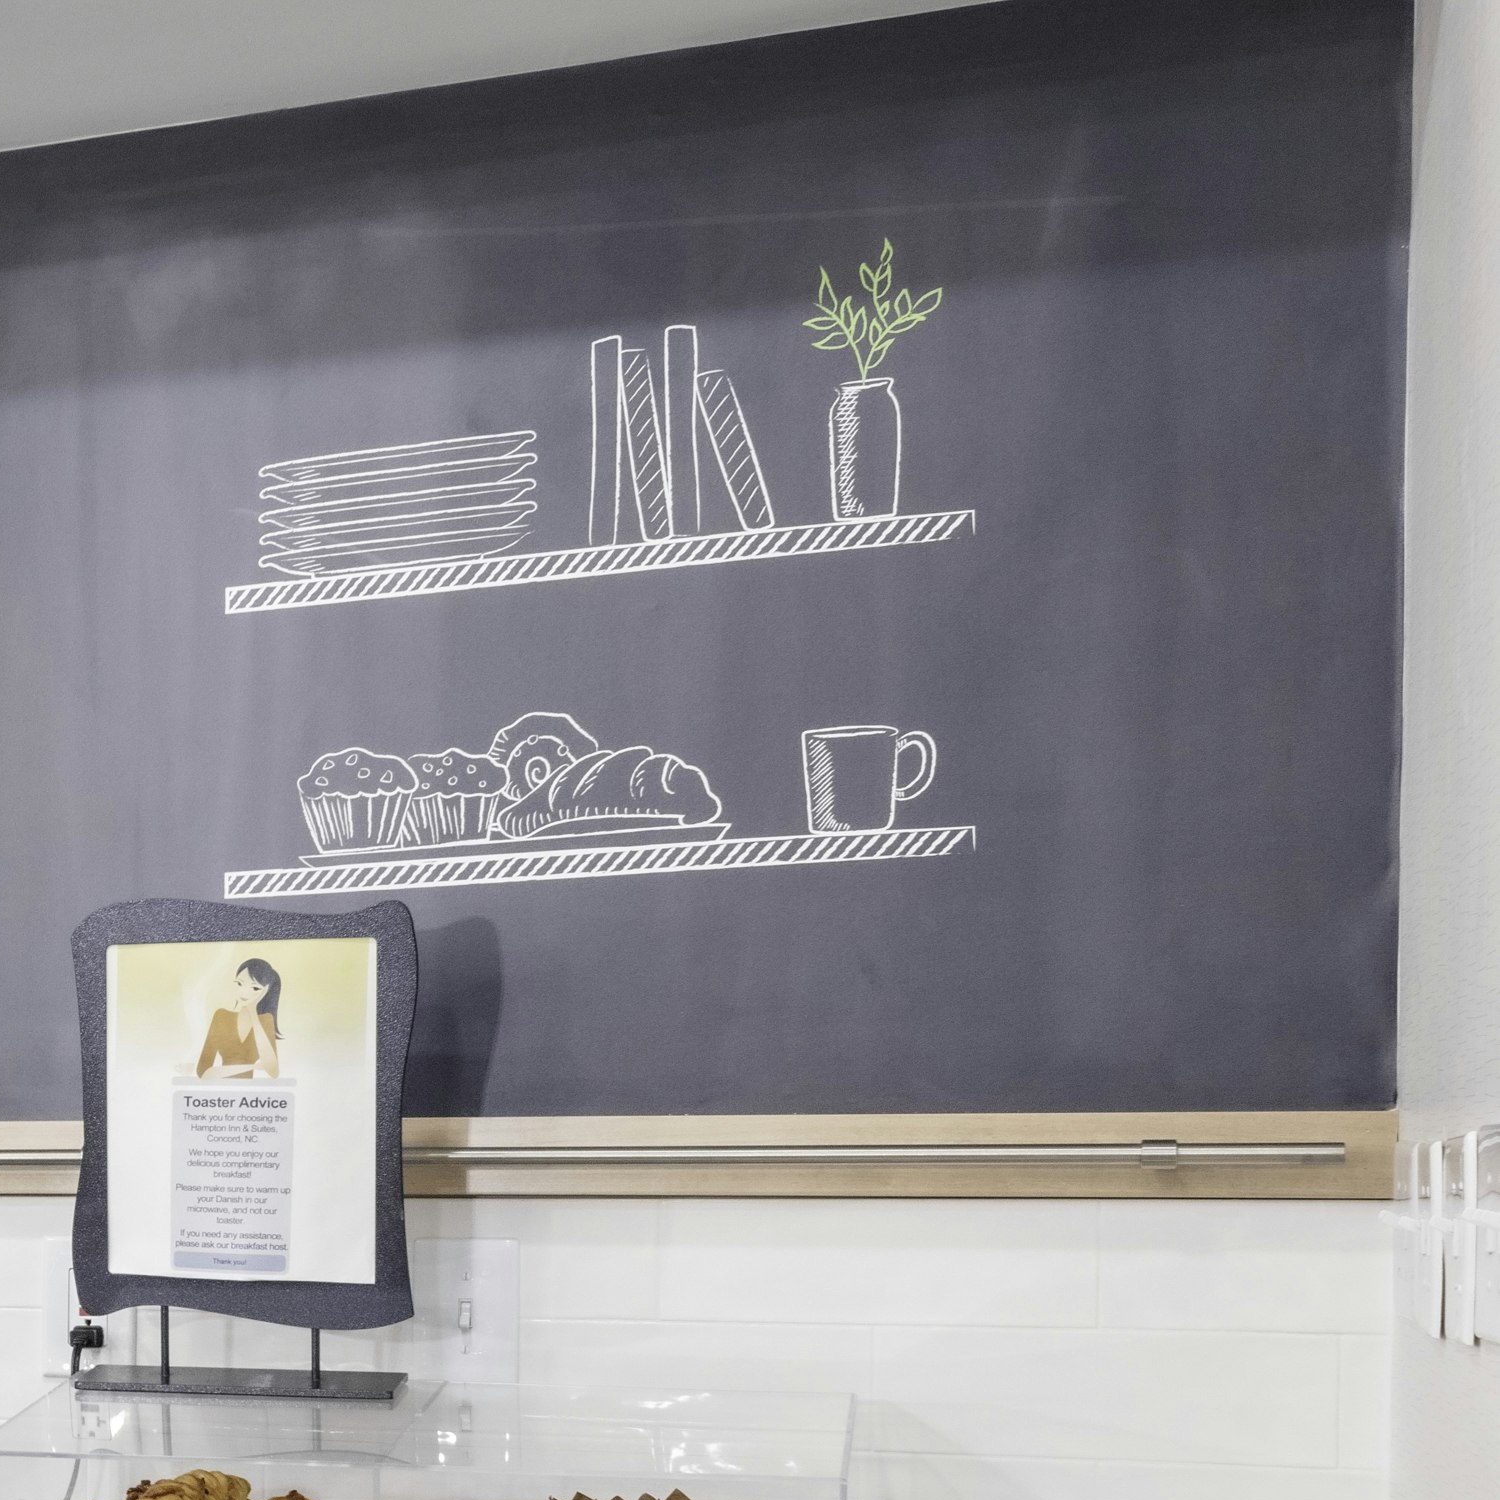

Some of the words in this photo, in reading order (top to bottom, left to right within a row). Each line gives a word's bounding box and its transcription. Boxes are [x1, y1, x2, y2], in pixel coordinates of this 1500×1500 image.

[183, 1095, 236, 1108] Toaster
[239, 1096, 288, 1109] Advice
[182, 1112, 207, 1121] Thank
[208, 1114, 224, 1123] you
[224, 1113, 236, 1122] for
[236, 1113, 273, 1124] choosing
[274, 1114, 288, 1123] the
[190, 1123, 227, 1134] Hampton
[228, 1124, 241, 1133] Inn
[242, 1124, 249, 1133] &
[250, 1124, 279, 1135] Suites,
[206, 1134, 243, 1144] Concord,
[188, 1148, 203, 1157] We
[203, 1148, 225, 1159] hope
[225, 1150, 241, 1159] you
[241, 1150, 264, 1160] enjoy
[264, 1151, 280, 1159] our
[186, 1159, 221, 1168] delicious
[221, 1159, 281, 1171] complimentary
[213, 1170, 252, 1179] breakfast!
[175, 1183, 202, 1192] Please
[203, 1184, 226, 1193] make
[226, 1185, 245, 1193] sure
[246, 1185, 255, 1194] to
[255, 1186, 279, 1194] warm
[280, 1187, 292, 1196] up
[196, 1195, 215, 1204] your
[215, 1194, 244, 1204] Danish
[244, 1195, 253, 1204] in
[253, 1196, 268, 1205] our
[186, 1205, 231, 1215] microwave,
[232, 1206, 248, 1215] and
[249, 1206, 263, 1215] not
[263, 1208, 278, 1216] our
[180, 1228, 186, 1237] If
[186, 1230, 201, 1239] you
[201, 1229, 222, 1239] need
[222, 1231, 238, 1241] any
[238, 1231, 284, 1242] assistance,
[175, 1239, 201, 1249] please
[201, 1240, 215, 1249] ask
[215, 1241, 230, 1249] our
[230, 1241, 268, 1251] breakfast
[268, 1242, 289, 1252] host.
[212, 1257, 232, 1266] Thank
[232, 1258, 248, 1267] you!
